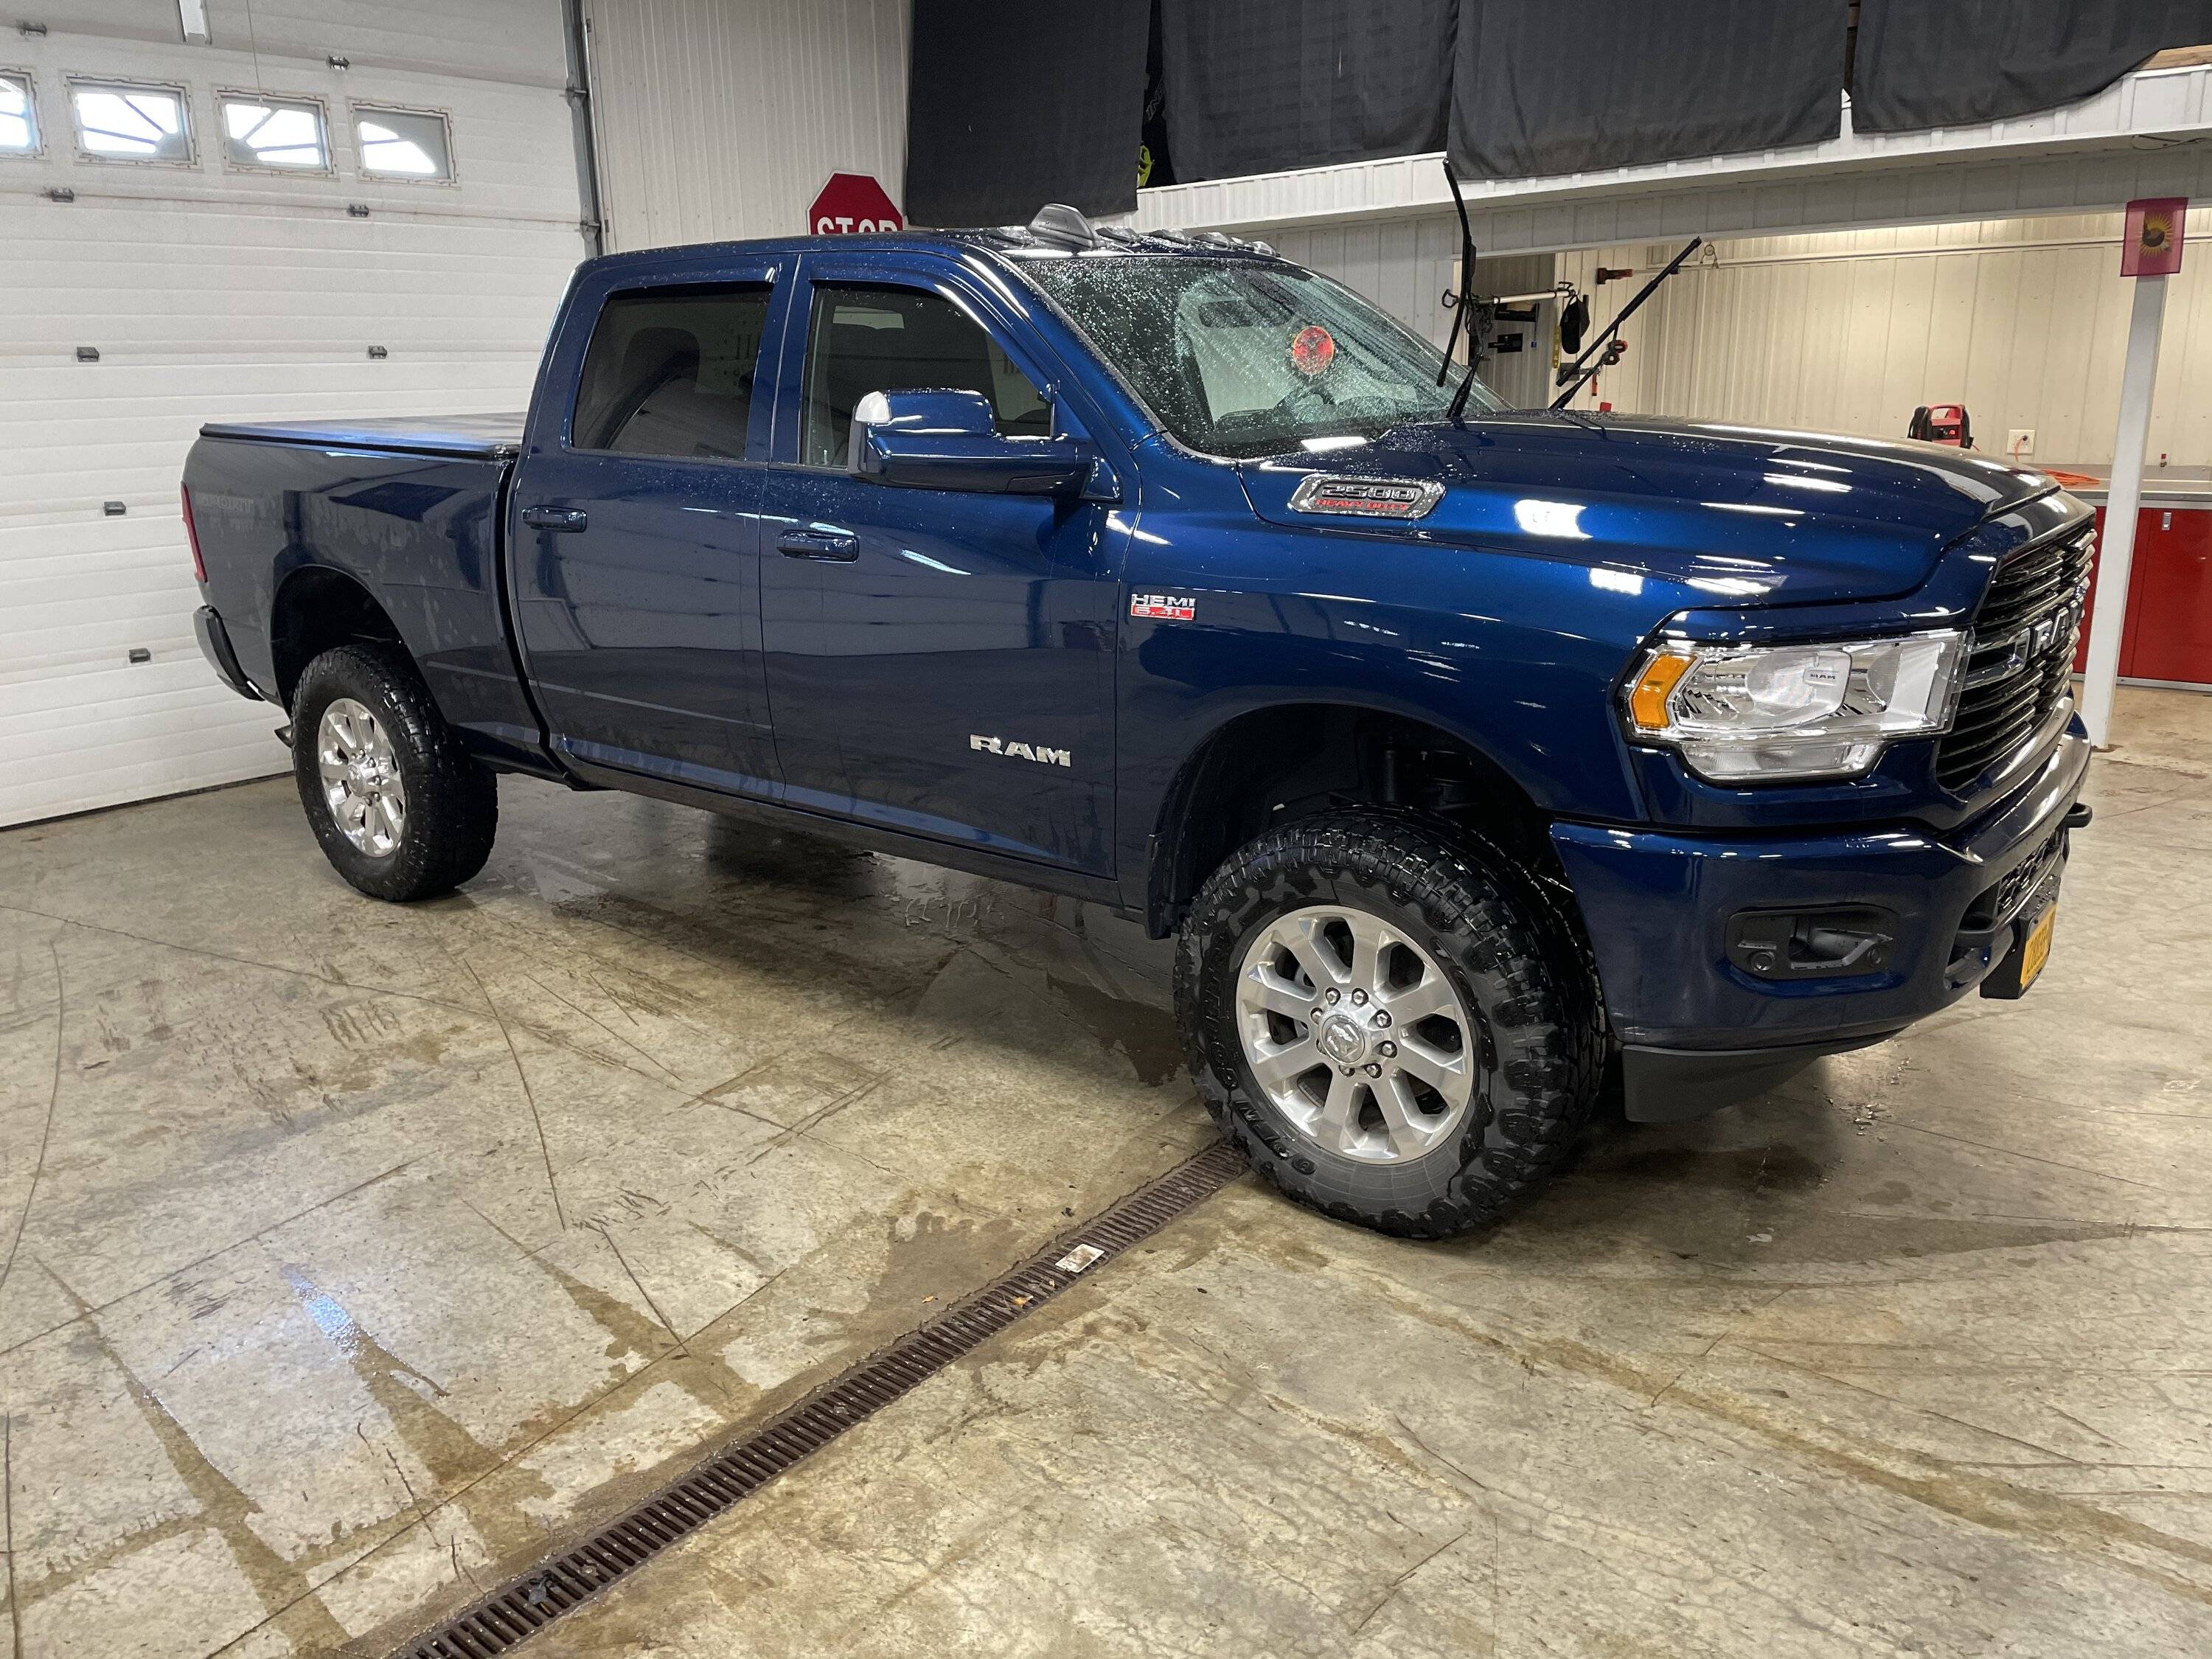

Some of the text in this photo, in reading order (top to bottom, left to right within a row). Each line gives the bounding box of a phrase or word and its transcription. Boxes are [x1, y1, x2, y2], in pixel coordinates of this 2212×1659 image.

[817, 216, 898, 235] ST
[1322, 485, 1415, 502] 2500
[1315, 498, 1411, 510] HEAVY DUTY
[1131, 594, 1196, 608] HEMI
[970, 734, 1071, 768] RAM
